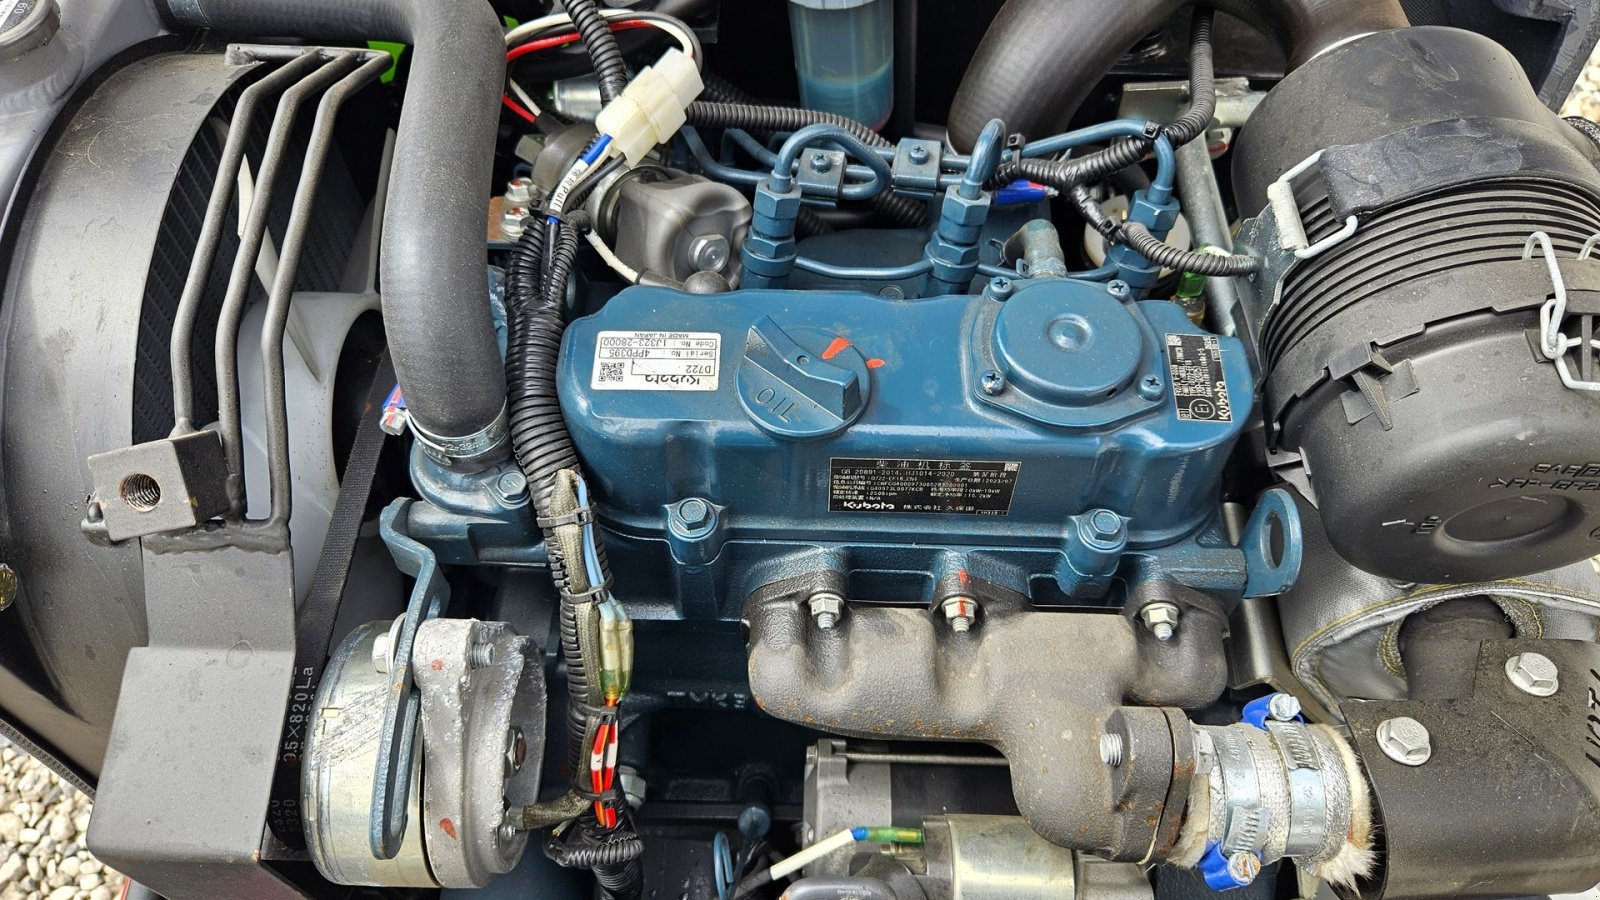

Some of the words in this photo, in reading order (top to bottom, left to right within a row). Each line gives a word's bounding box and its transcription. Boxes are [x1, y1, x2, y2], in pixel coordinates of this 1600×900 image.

[604, 338, 666, 346] 1J323-28000
[686, 364, 712, 374] D722
[645, 374, 700, 385] Kubota
[755, 387, 795, 423] OIL
[1214, 380, 1230, 420] Kubota
[844, 502, 895, 510] Kubota
